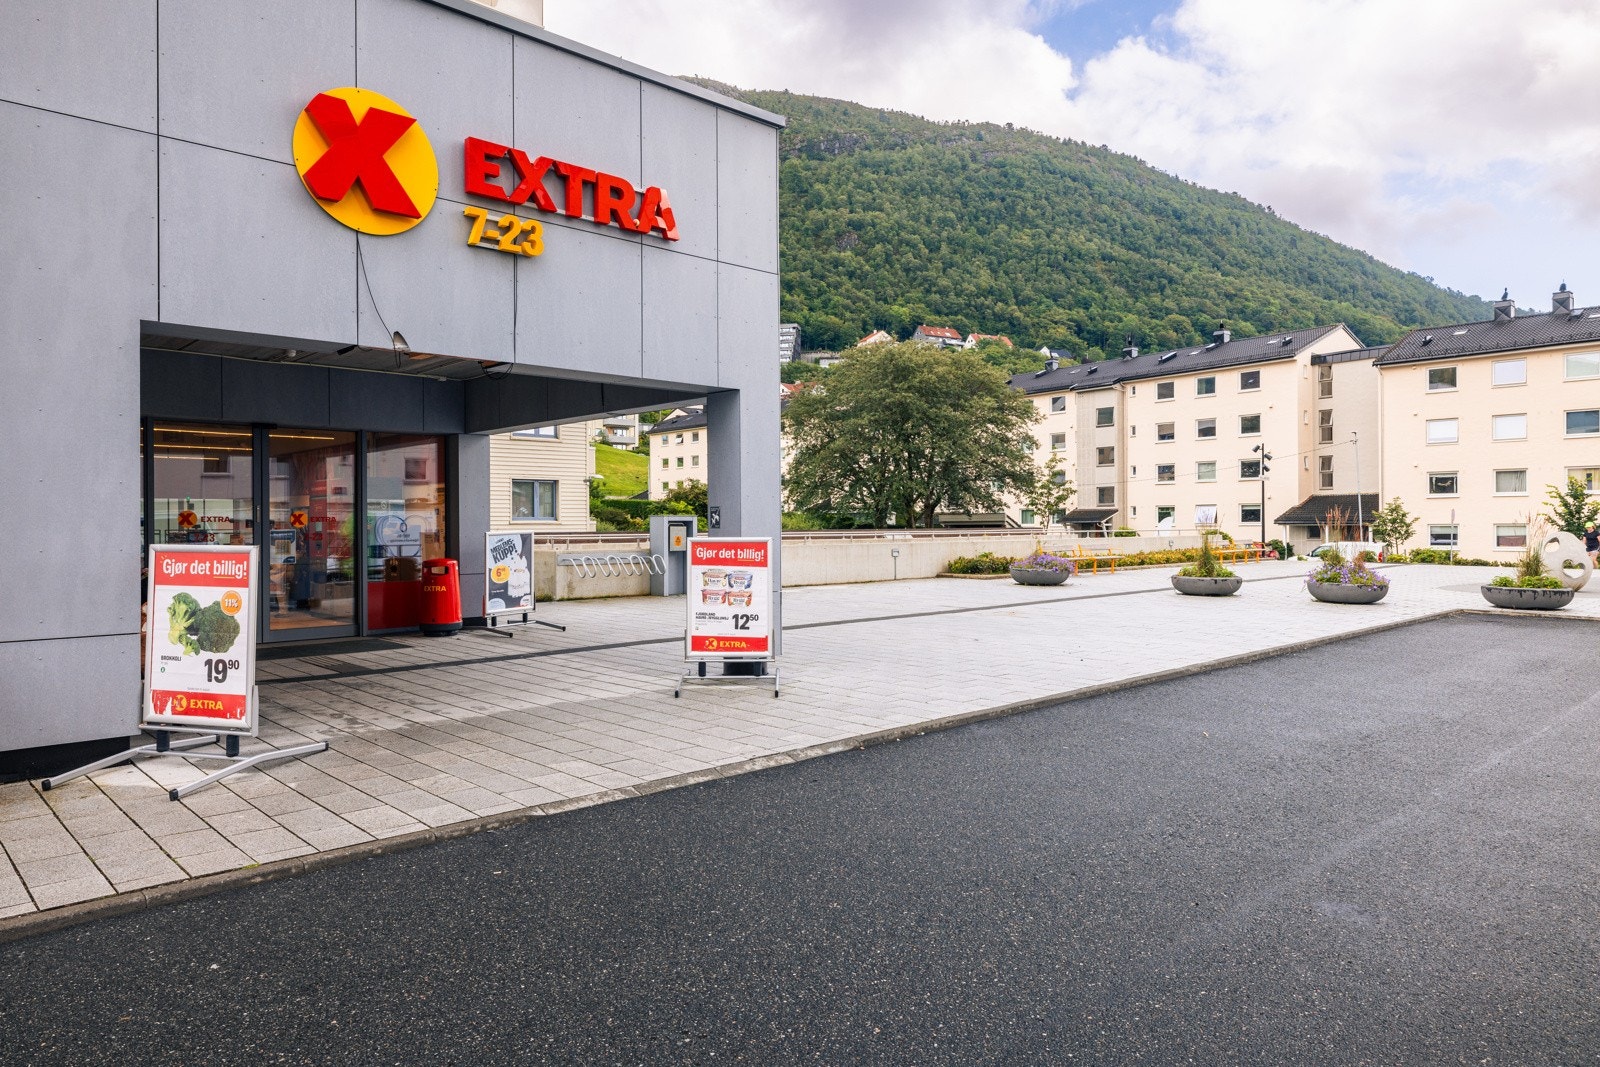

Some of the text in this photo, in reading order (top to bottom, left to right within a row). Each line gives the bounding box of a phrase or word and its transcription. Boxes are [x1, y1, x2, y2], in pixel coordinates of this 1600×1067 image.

[464, 136, 680, 242] EXTRA
[463, 206, 545, 258] 7-23
[492, 544, 518, 564] KUPP!
[697, 548, 765, 562] Gjør det billig!
[163, 559, 248, 580] Gjør det billig!
[189, 699, 224, 711] EXTRA
